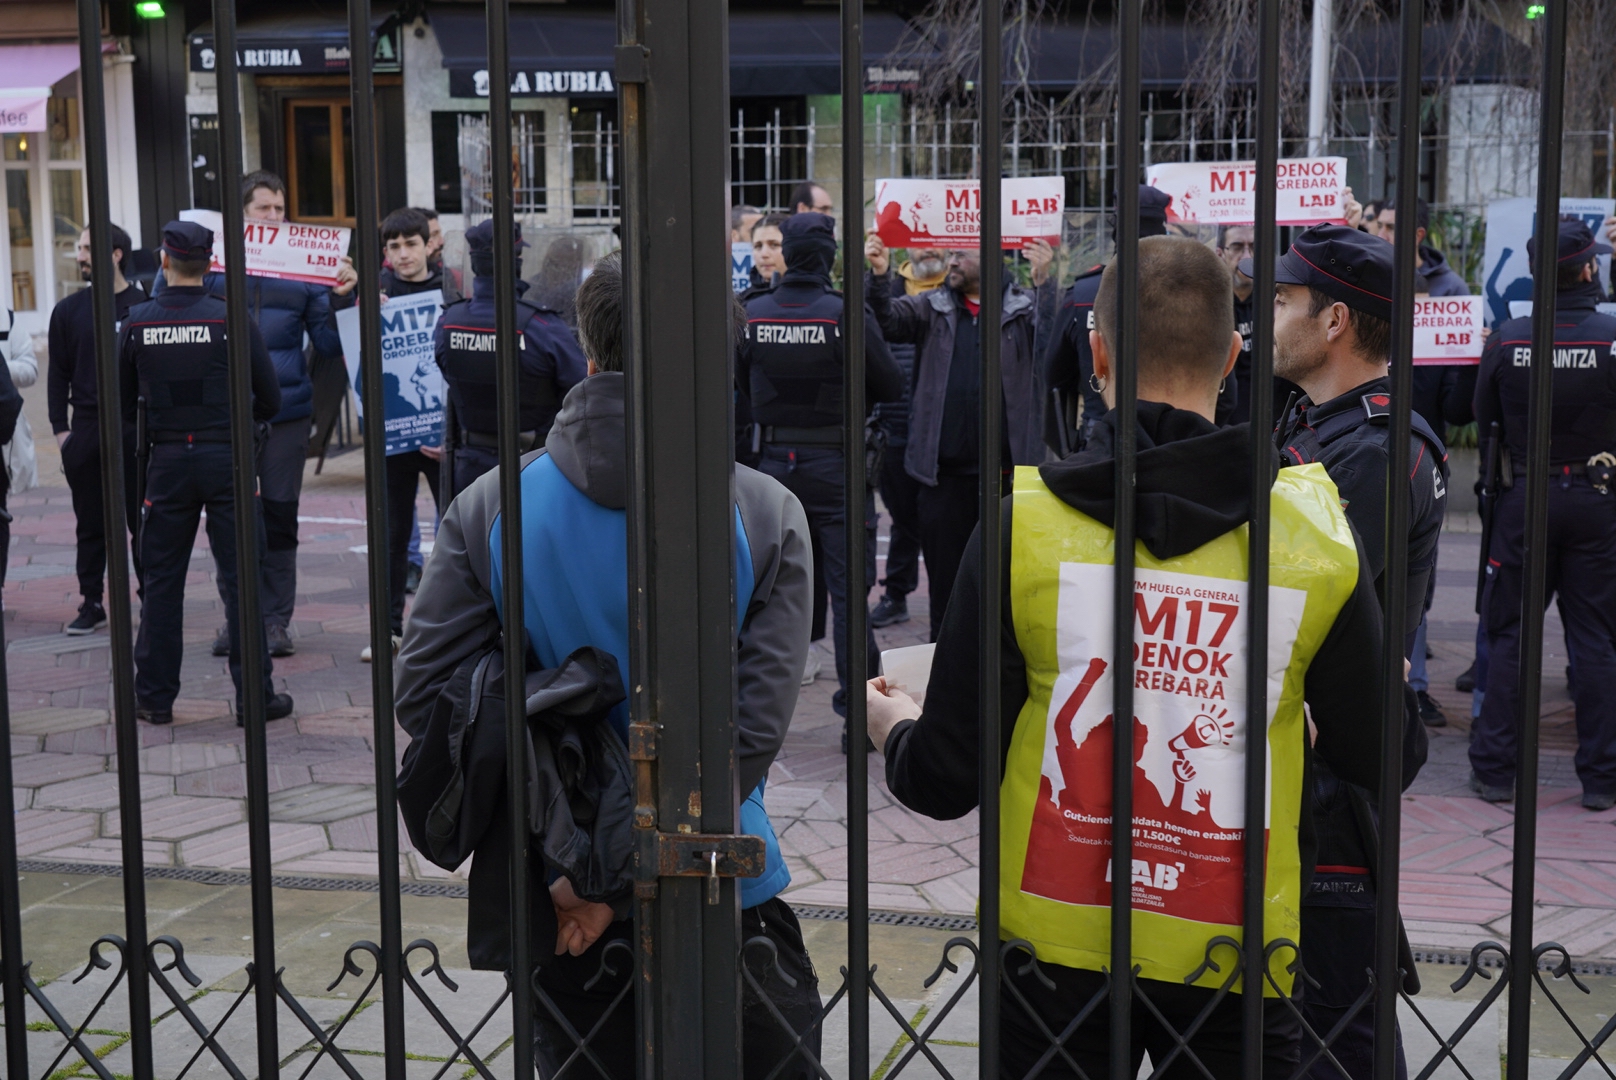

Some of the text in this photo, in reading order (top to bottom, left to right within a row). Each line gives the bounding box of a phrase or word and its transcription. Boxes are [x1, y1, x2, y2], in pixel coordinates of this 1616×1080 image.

[244, 49, 302, 67] RUBIA
[324, 47, 351, 60] Mah
[510, 71, 614, 93] A RUBIA
[0, 110, 28, 127] fee
[1276, 161, 1338, 178] DENOK
[1276, 177, 1338, 190] GREBARA
[946, 188, 980, 211] M1
[1011, 197, 1059, 216] LAB
[1209, 198, 1246, 207] GASTEIZ
[1300, 194, 1337, 208] LAB
[945, 211, 981, 223] DEN
[288, 225, 341, 241] DENOK
[945, 224, 981, 234] GREB
[245, 247, 262, 255] TEIZ
[287, 237, 341, 252] GREBARA
[306, 254, 339, 268] LAB
[1414, 301, 1472, 316] DENOK
[381, 304, 437, 337] M17
[1413, 316, 1473, 328] GREBARA
[143, 325, 212, 346] ERTZAINTZA
[450, 331, 526, 352] ERTZAINTA
[756, 325, 827, 344] ERTZAINTZA
[1434, 332, 1472, 346] LAB
[383, 344, 436, 361] OROKOR
[1513, 346, 1598, 369] ERINTZA
[1149, 582, 1191, 597] HUELGA
[1194, 589, 1240, 603] GENERAL
[1134, 592, 1239, 649] M17
[1134, 669, 1225, 701] REBARA
[1063, 809, 1113, 825] Gutxiene
[1132, 816, 1163, 829] oldata
[1164, 821, 1200, 838] hemen
[1202, 831, 1242, 841] erabaki
[1142, 829, 1181, 846] 1.500€
[1068, 834, 1103, 846] Soldatak
[1134, 840, 1188, 856] aberastasuna
[1188, 850, 1231, 864] banatzeko
[1311, 881, 1365, 893] ZAINTZA
